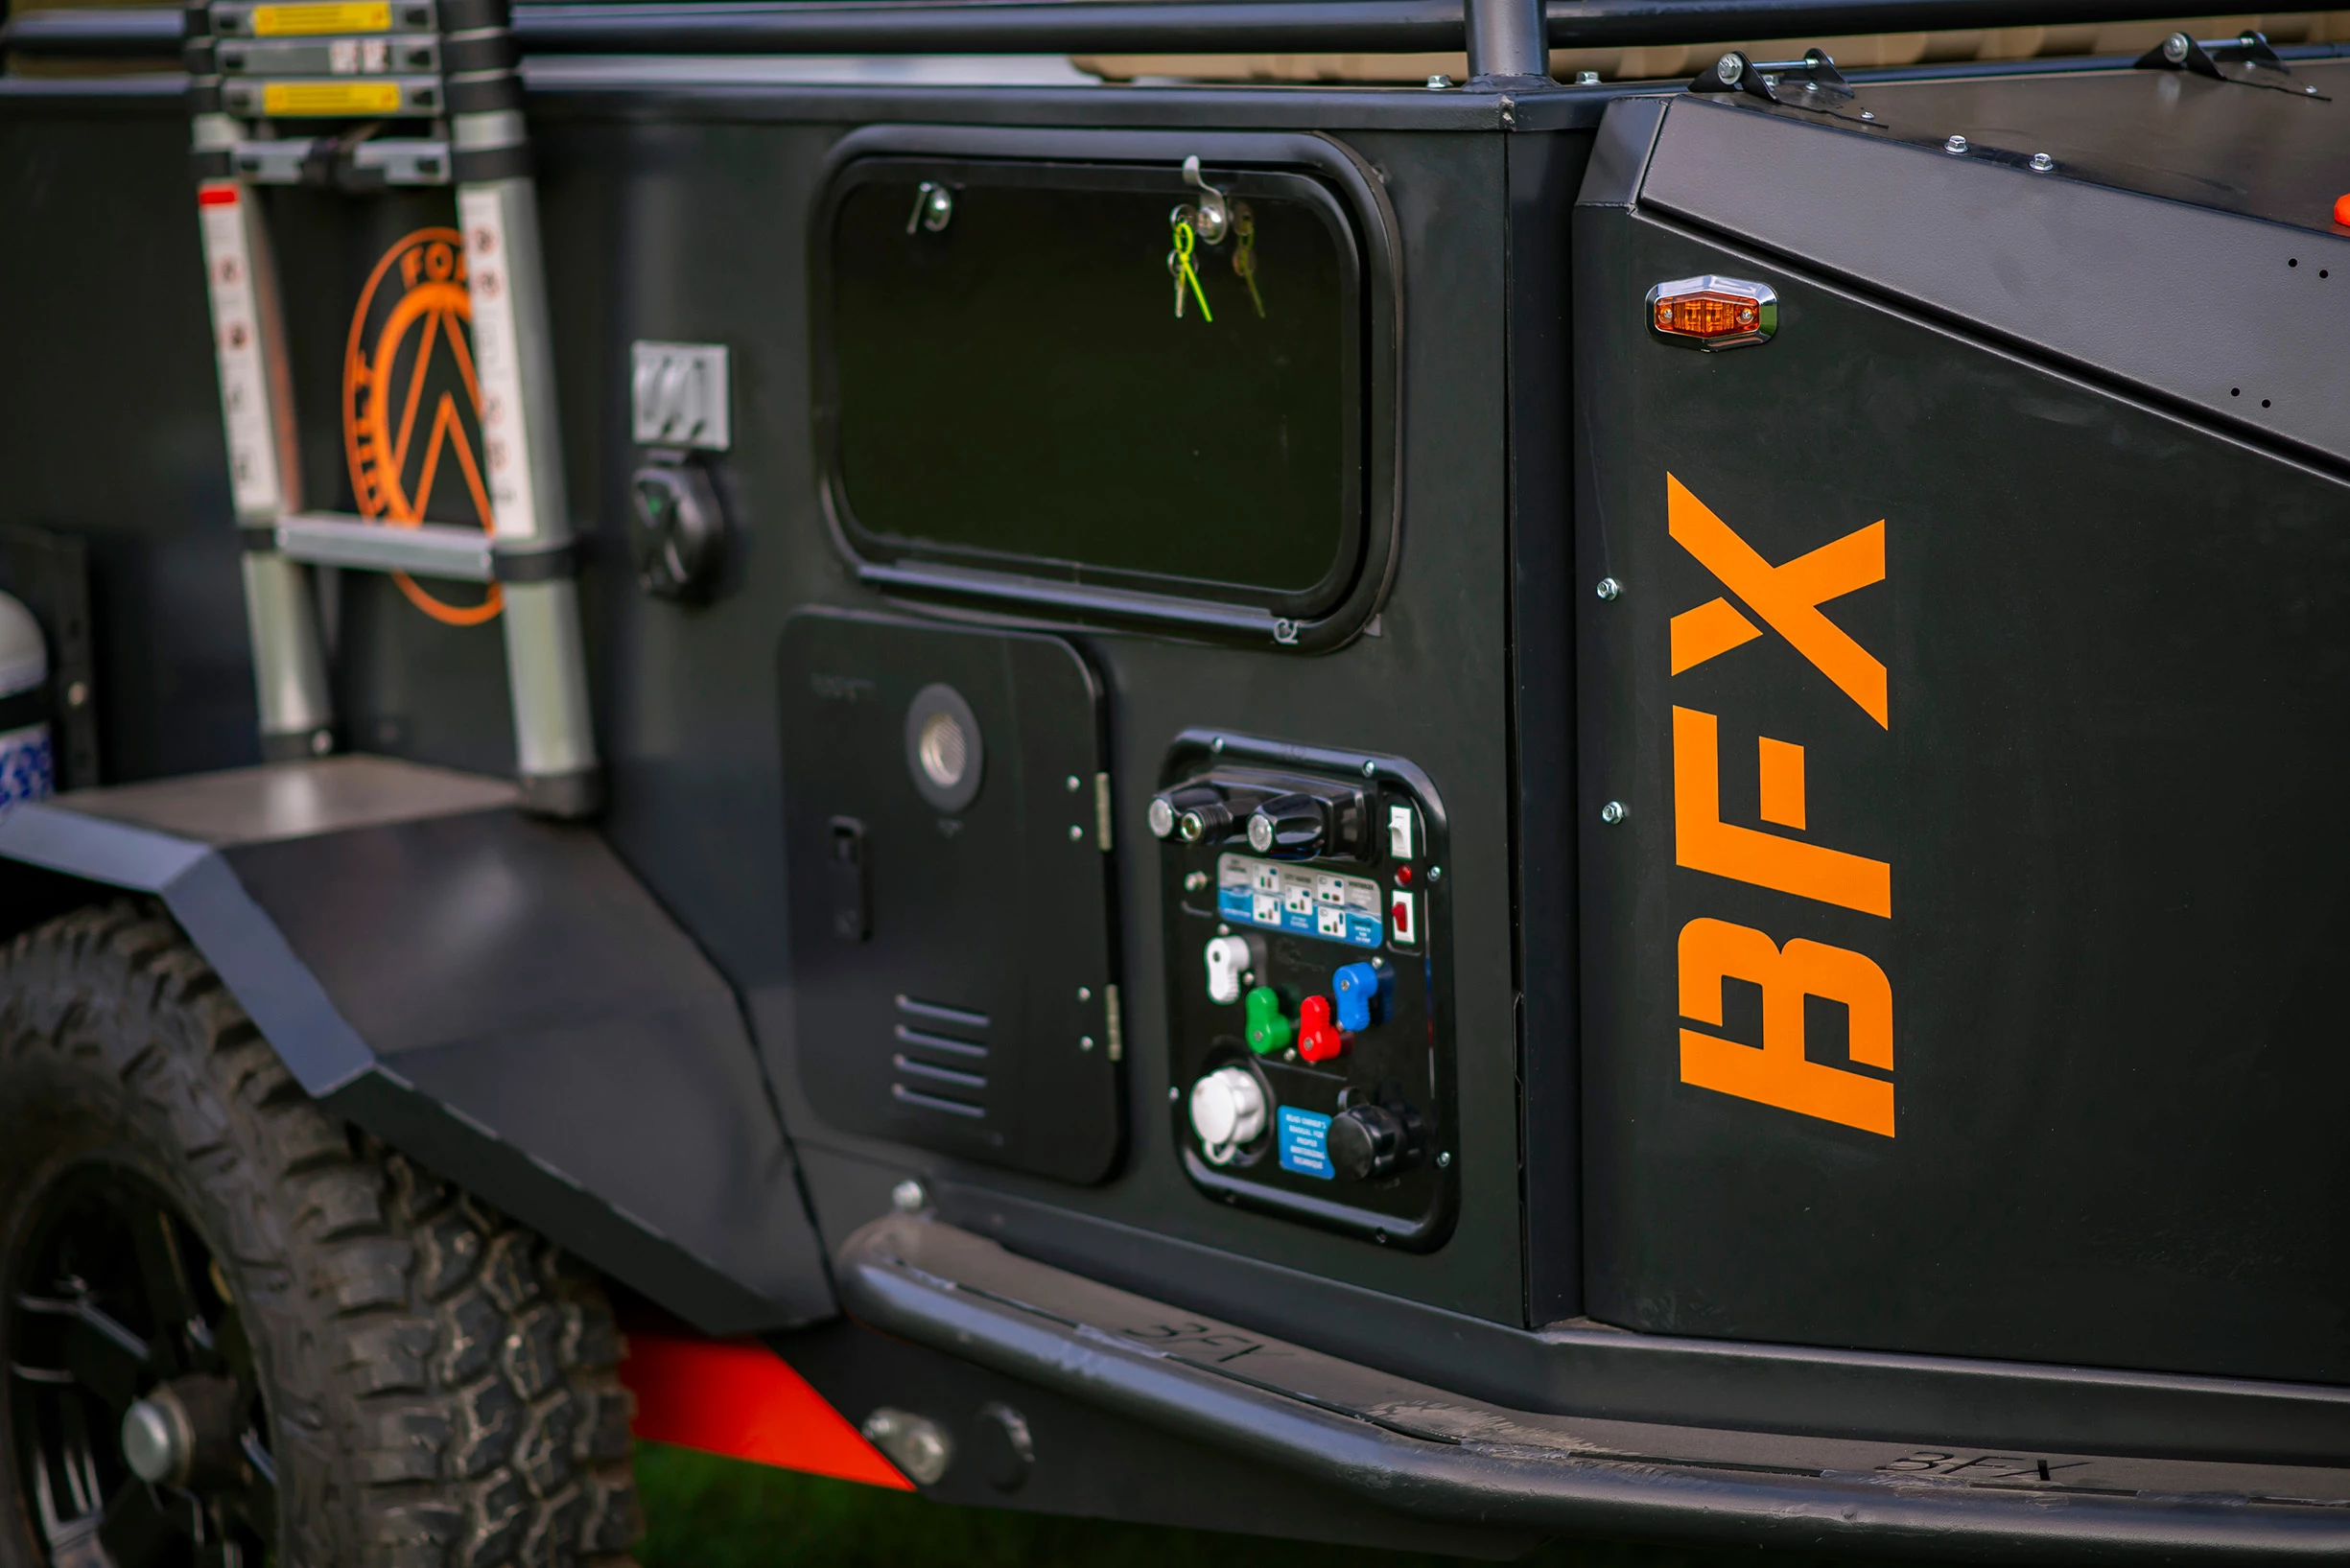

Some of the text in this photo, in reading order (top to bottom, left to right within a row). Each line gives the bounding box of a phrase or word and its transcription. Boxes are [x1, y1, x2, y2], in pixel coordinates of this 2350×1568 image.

[1667, 472, 1895, 1138] BFX
[1288, 1125, 1325, 1138] MANUAL FOR
[1873, 1451, 2095, 1482] BFX
